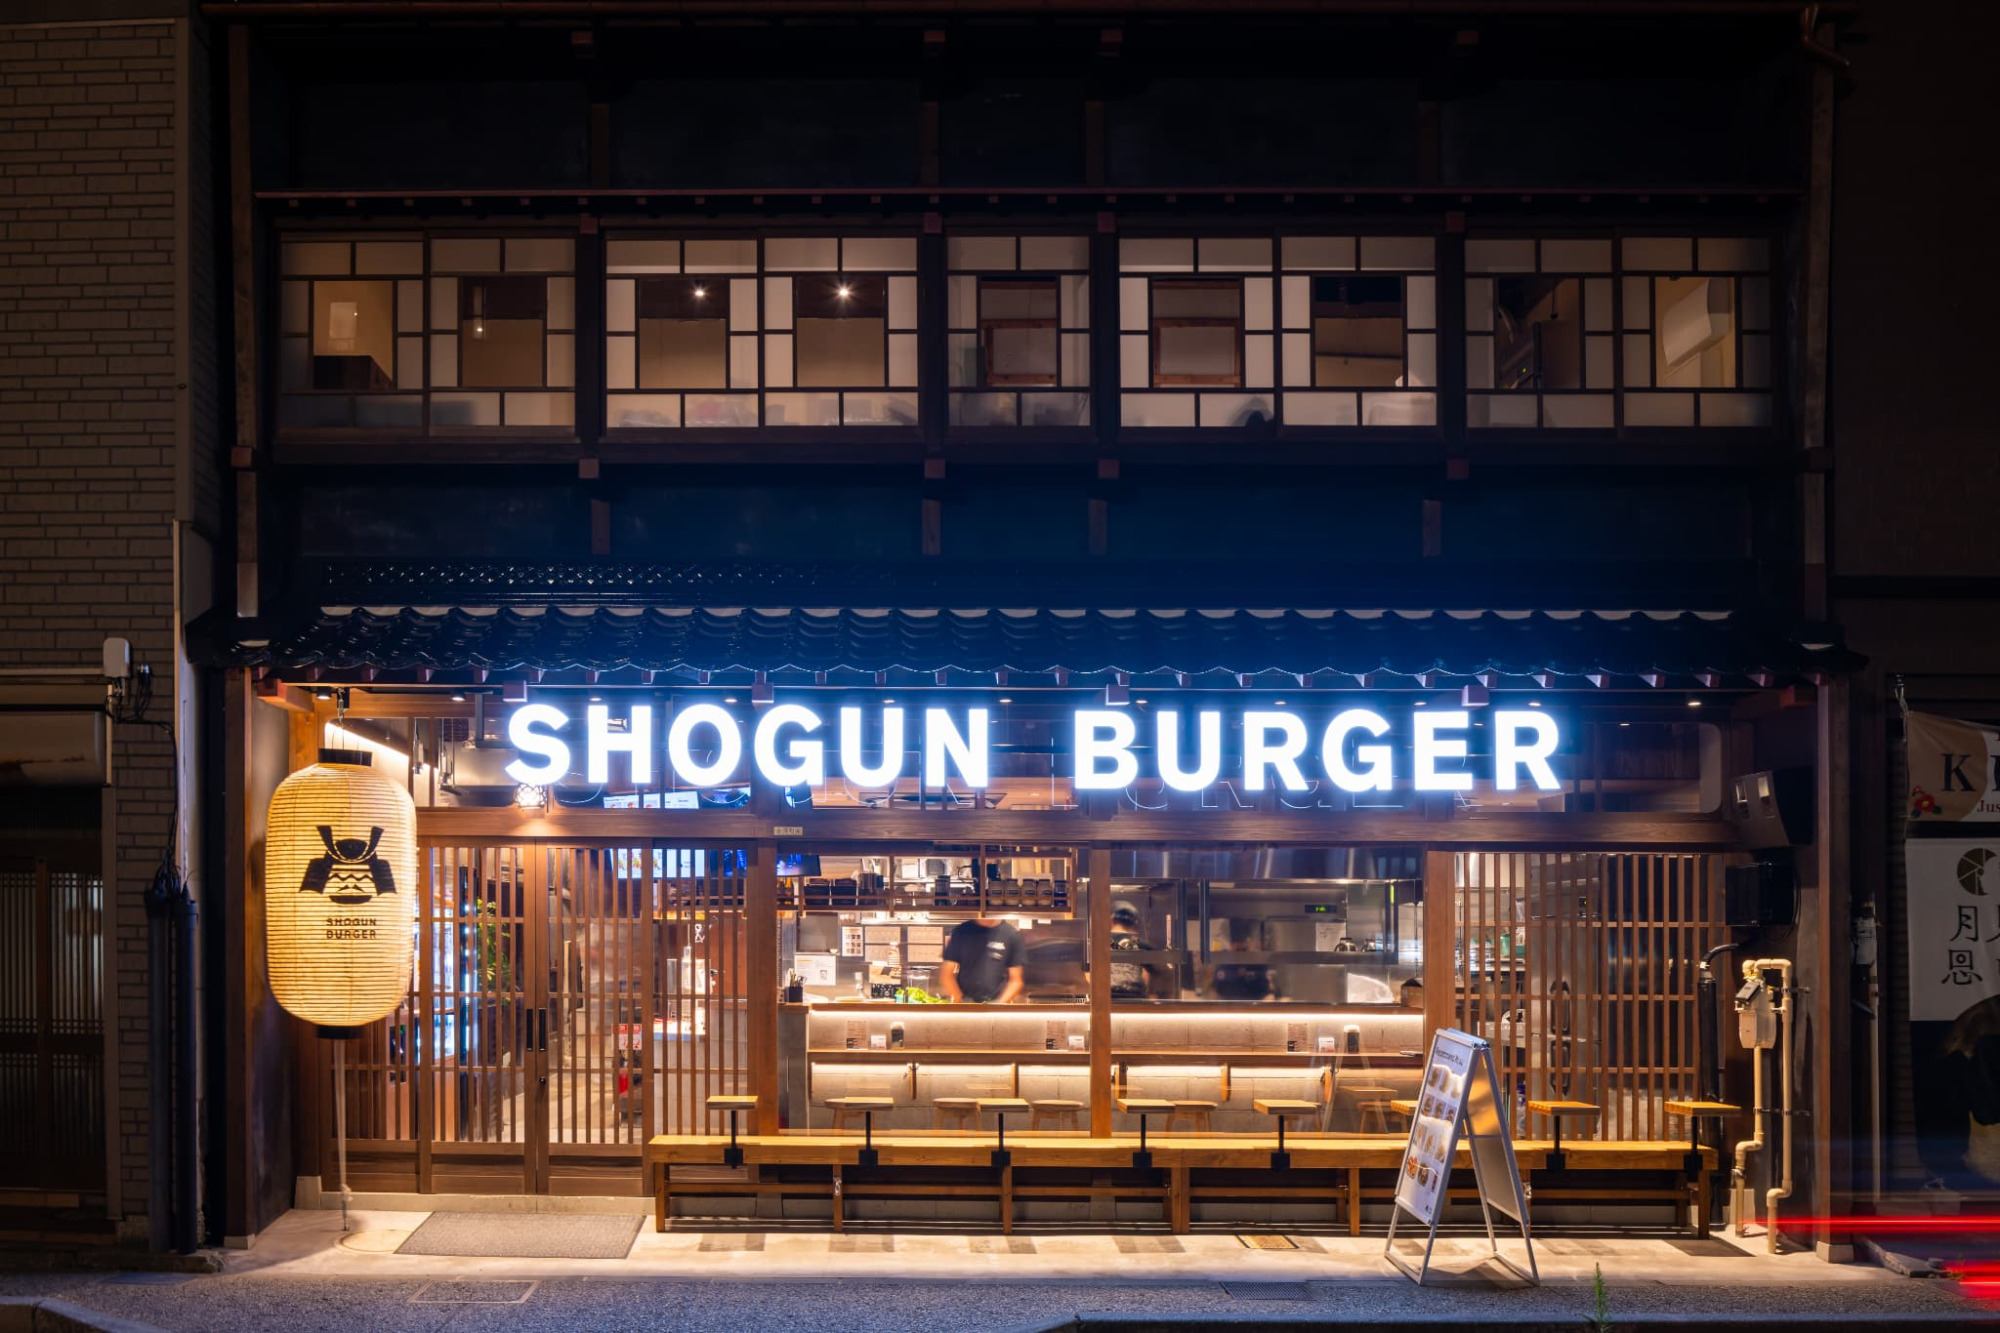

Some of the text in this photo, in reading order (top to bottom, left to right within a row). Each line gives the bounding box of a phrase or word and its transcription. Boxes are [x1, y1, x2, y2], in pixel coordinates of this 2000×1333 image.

[505, 703, 1560, 792] SHOGUN BURGER
[326, 918, 377, 926] SHOGUN
[326, 930, 377, 939] BURGER
